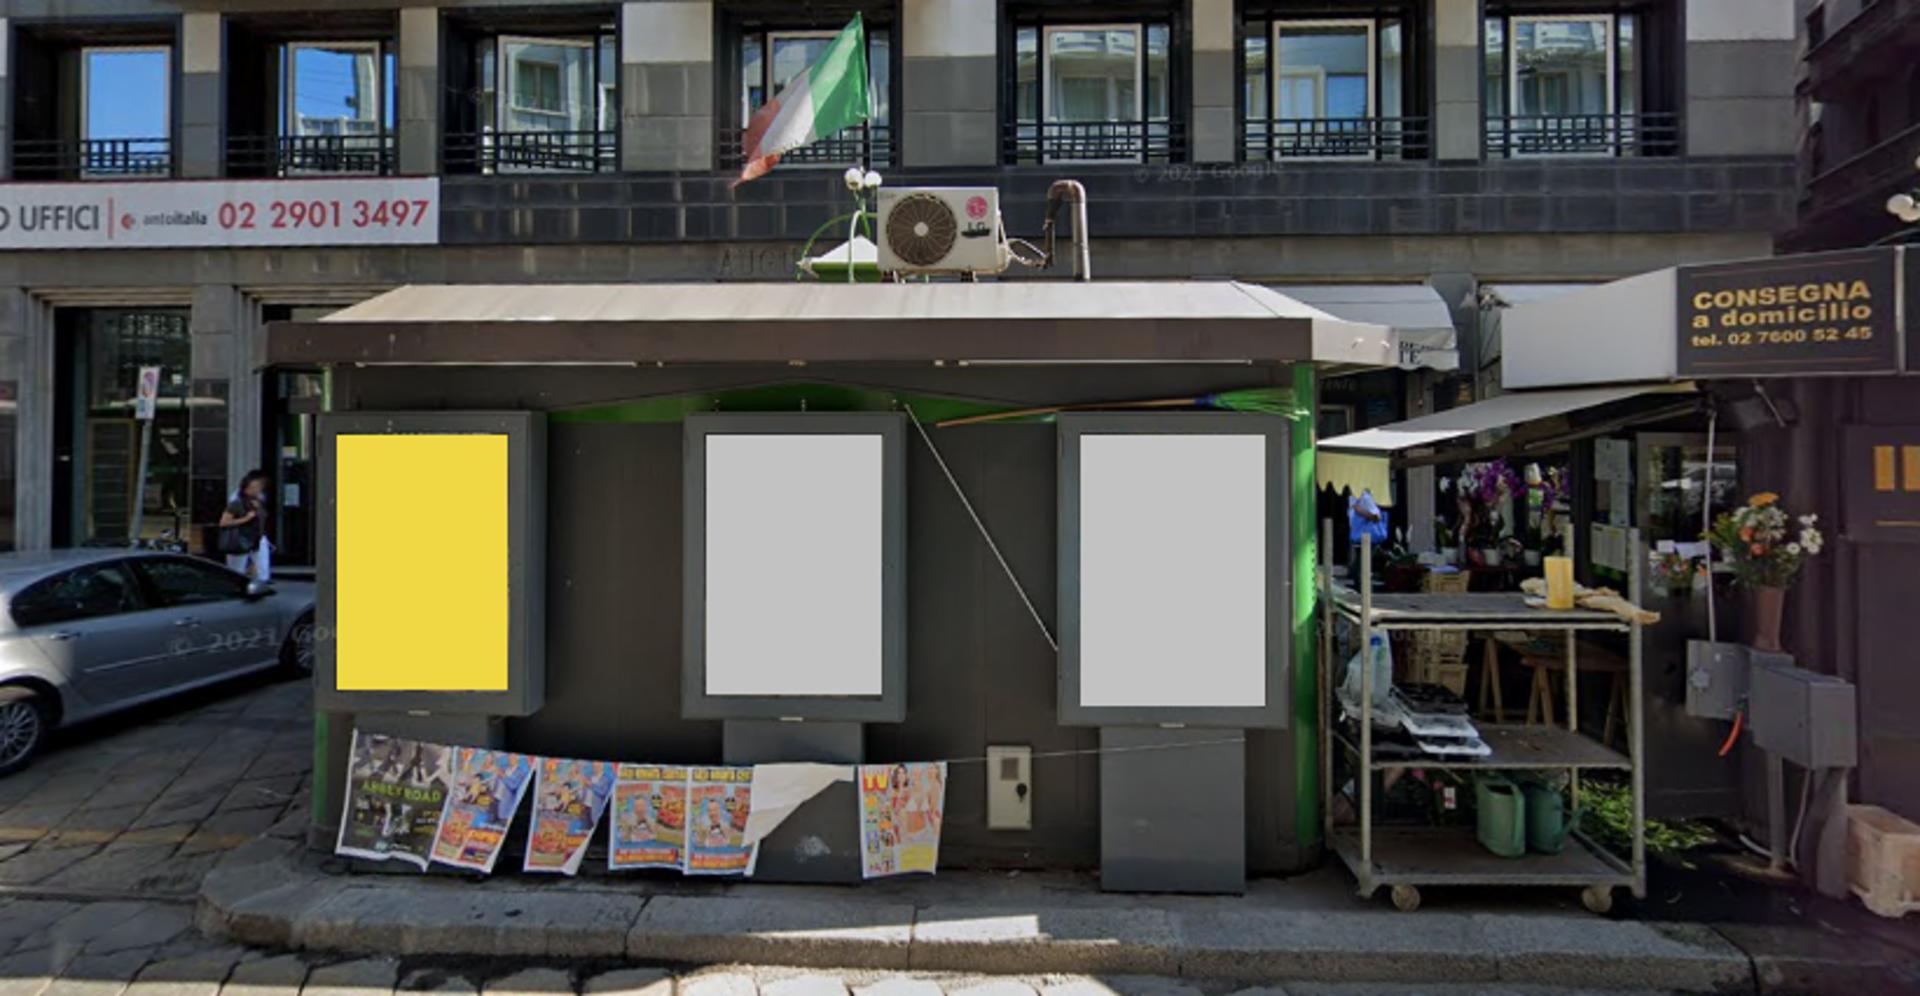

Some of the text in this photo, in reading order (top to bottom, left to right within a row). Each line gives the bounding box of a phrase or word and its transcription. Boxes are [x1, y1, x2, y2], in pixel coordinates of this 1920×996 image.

[20, 205, 100, 230] UFFICI
[218, 202, 256, 229] 02
[270, 201, 342, 228] 2901
[352, 200, 429, 228] 3497
[1692, 280, 1872, 310] CONSEGNA
[1692, 302, 1873, 328] a domicilio
[1691, 326, 1873, 347] tel. 02 7600 52 45
